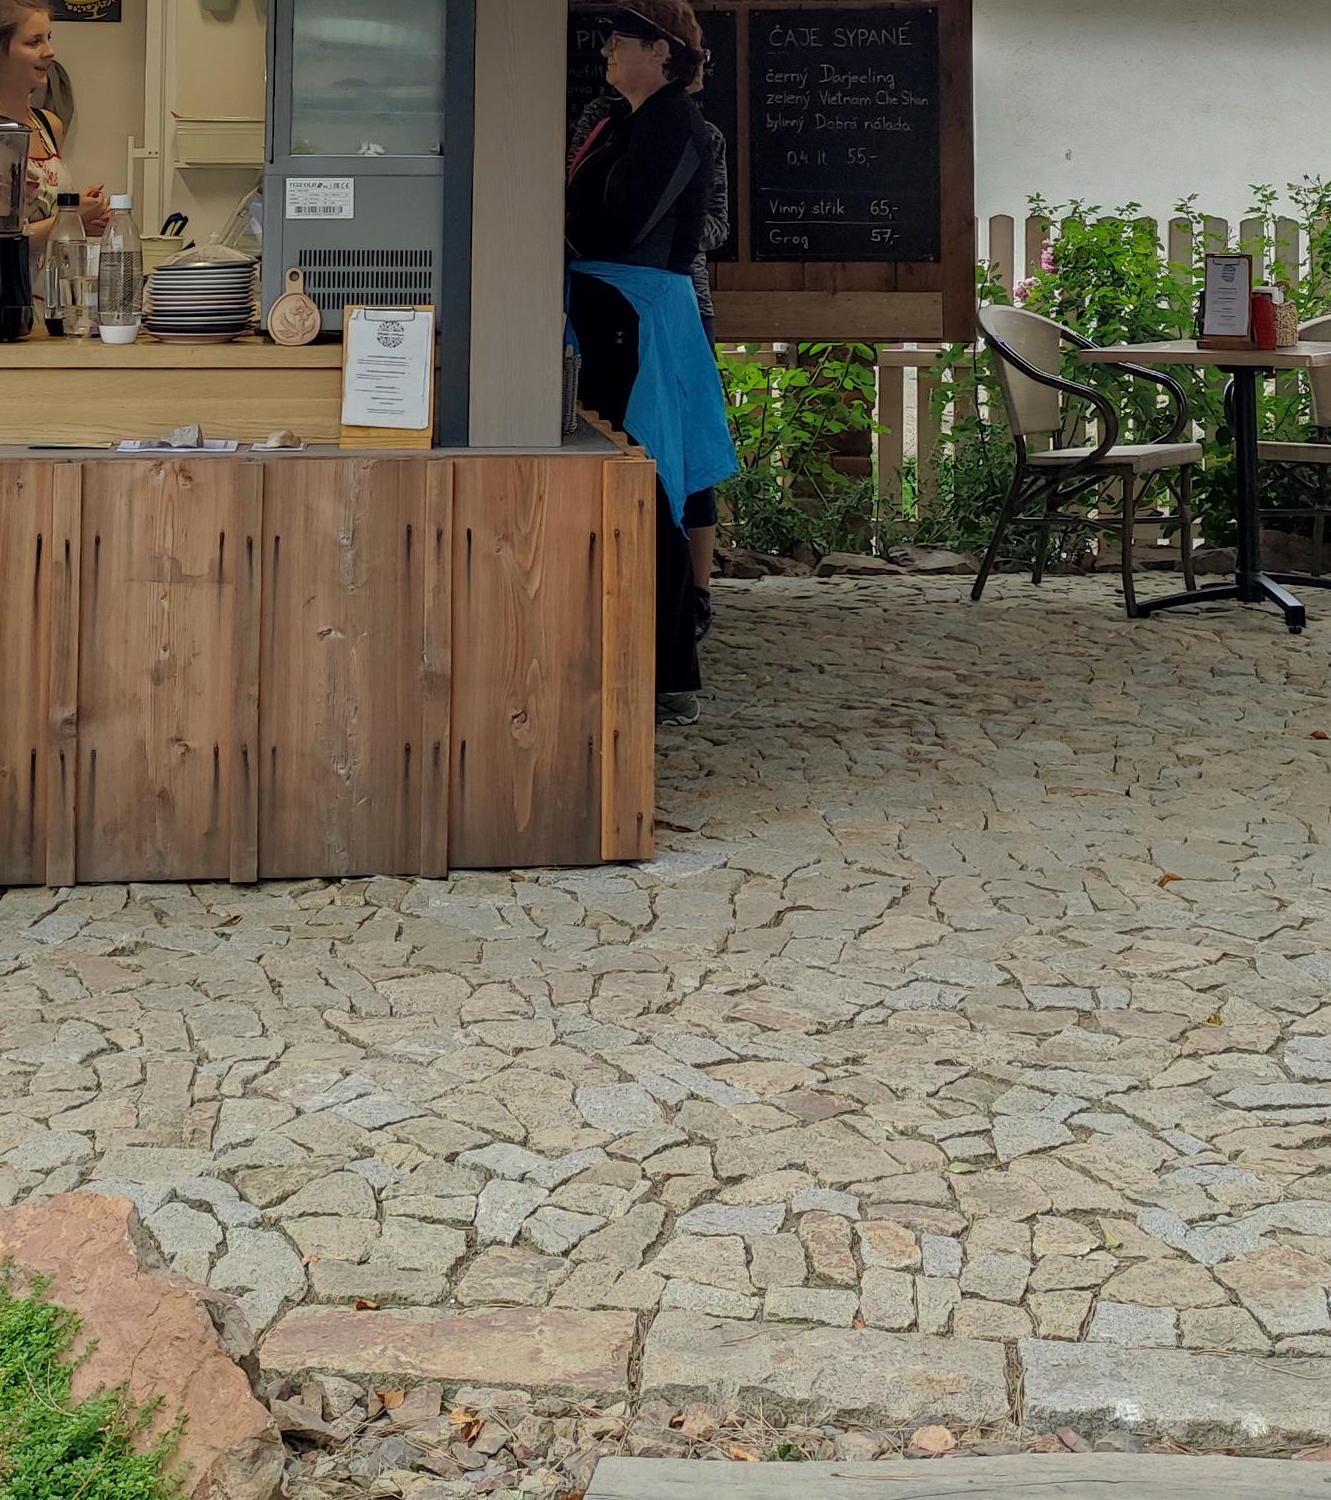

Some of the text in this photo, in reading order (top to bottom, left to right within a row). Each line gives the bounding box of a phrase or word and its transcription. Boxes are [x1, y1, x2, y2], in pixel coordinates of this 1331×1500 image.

[768, 20, 914, 48] ČAJE SYPANÉ
[765, 64, 896, 90] černý Darjeeling
[765, 90, 929, 110] zelený Vietnam Che Shan
[764, 112, 912, 133] bylinný Dobrá nálada
[786, 150, 809, 167] 0,4
[768, 198, 805, 219] Vinný
[811, 198, 845, 216] střik
[768, 228, 809, 250] Grog
